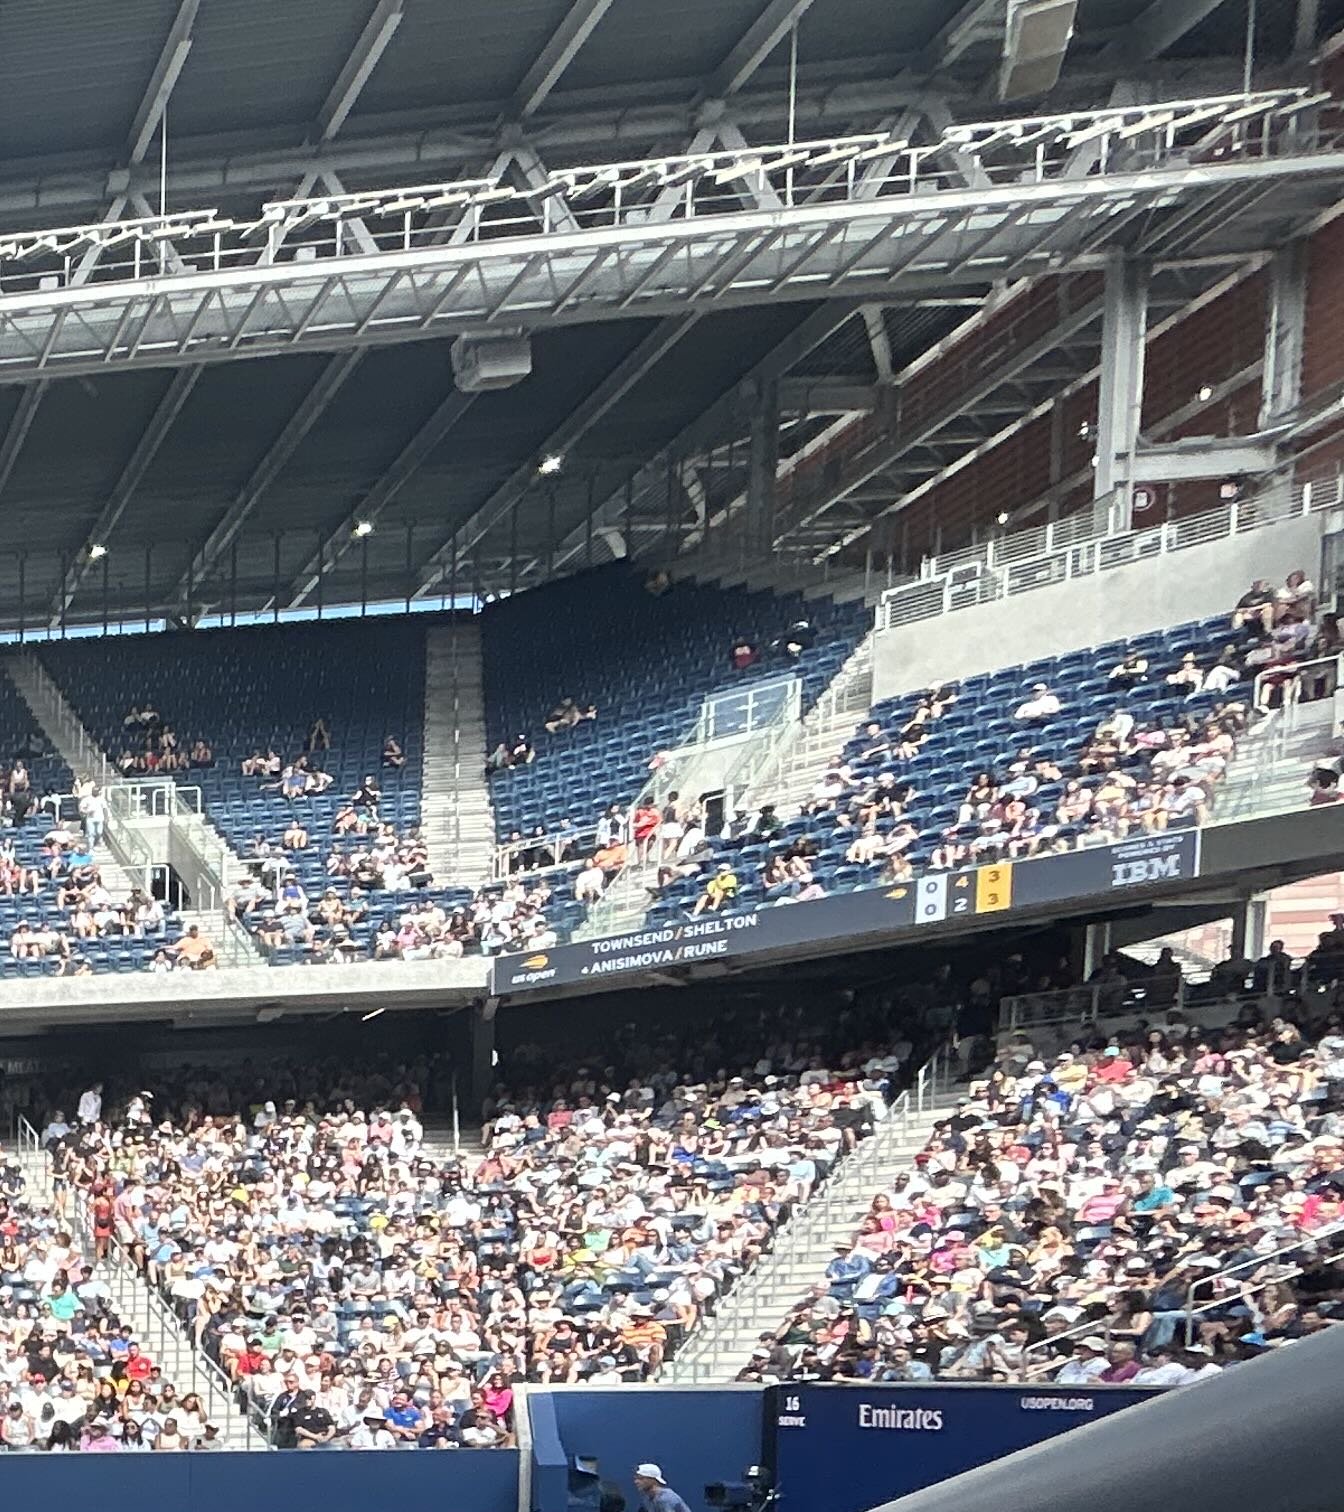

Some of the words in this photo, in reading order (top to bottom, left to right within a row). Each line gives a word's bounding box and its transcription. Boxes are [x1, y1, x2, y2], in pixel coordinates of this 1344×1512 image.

[926, 882, 938, 894] 0
[955, 876, 968, 888] 4
[989, 870, 1001, 882] 3
[1112, 854, 1180, 886] IBM
[925, 904, 937, 916] 0
[955, 899, 967, 912] 2
[988, 893, 999, 905] 3
[785, 1396, 800, 1411] 16
[859, 1403, 943, 1430] Emirates
